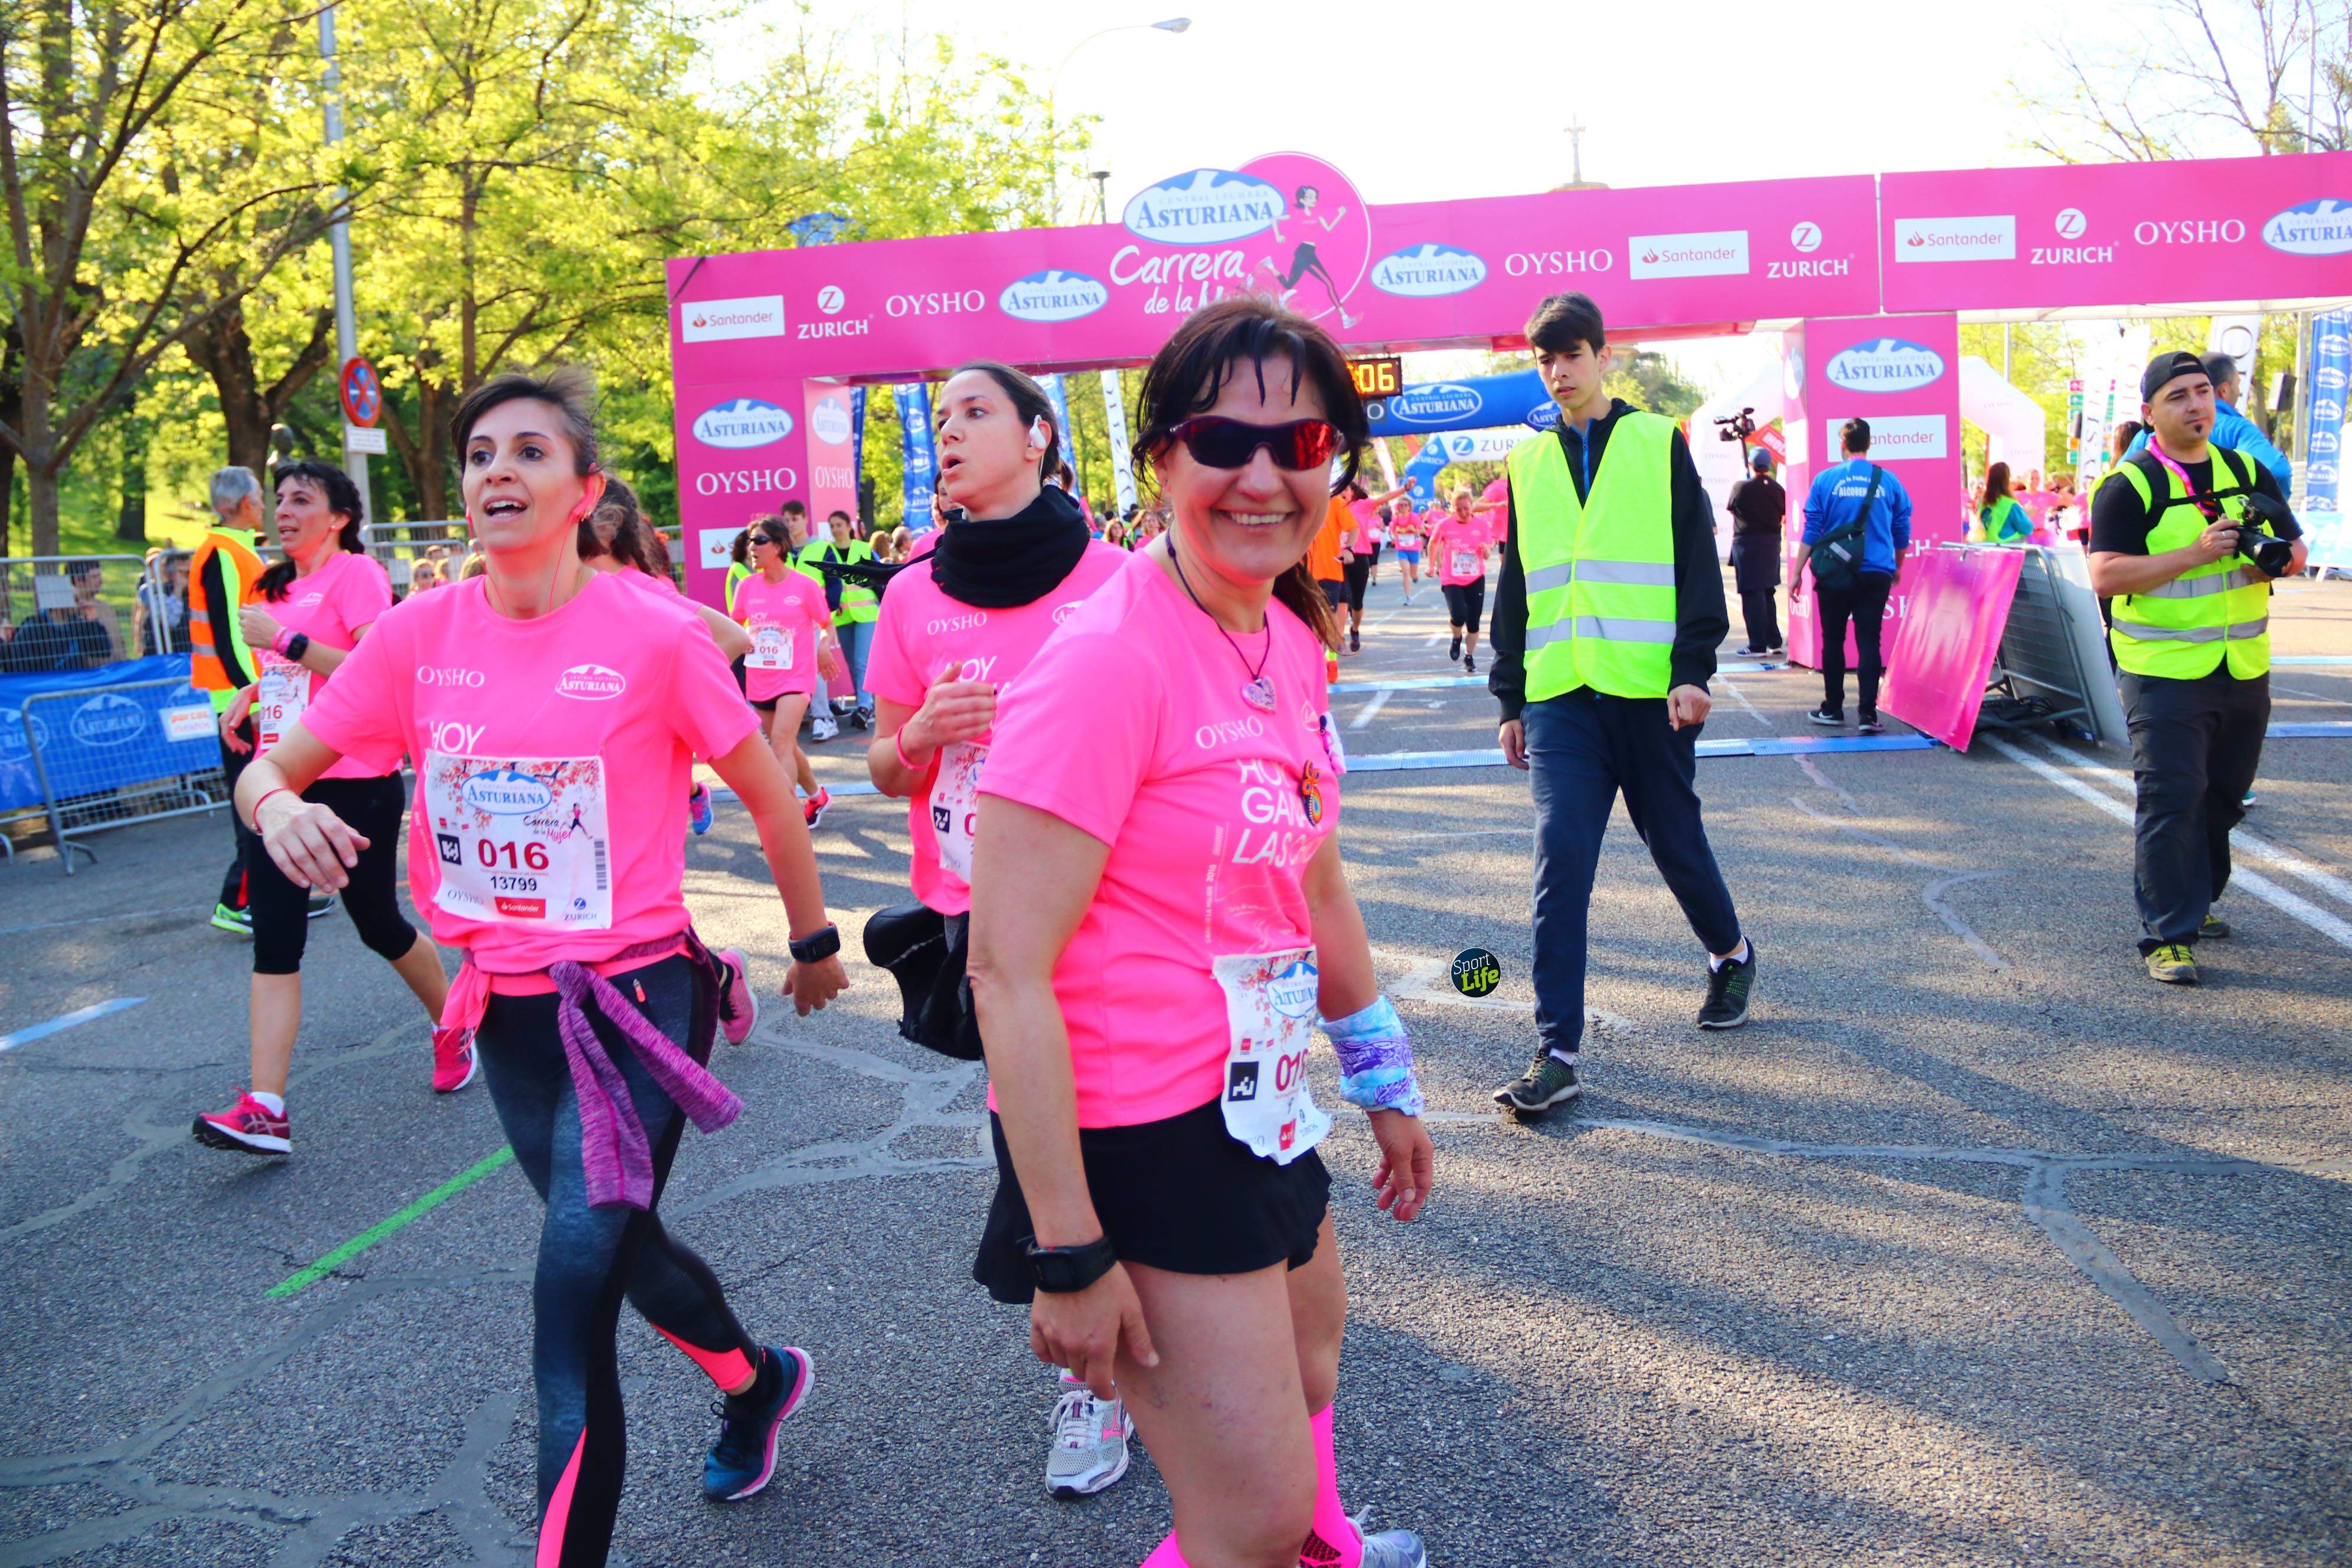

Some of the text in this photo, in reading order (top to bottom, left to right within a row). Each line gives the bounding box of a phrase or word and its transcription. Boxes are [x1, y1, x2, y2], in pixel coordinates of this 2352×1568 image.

[1159, 190, 1269, 205] CENTRAL LECHERA
[1135, 201, 1273, 229] ASTURIANA
[1928, 231, 2003, 246] Santander
[2134, 219, 2245, 244] OYSHO
[1505, 249, 1613, 276] OYSHO
[1662, 247, 1736, 263] Santander
[2030, 246, 2113, 264] ZURICH
[1109, 245, 1245, 286] Carrera
[1767, 259, 1849, 278] ZURICH
[1378, 265, 1479, 286] ASTURIANA
[886, 290, 985, 316] OYSHO
[1007, 291, 1100, 311] ASTURIANA
[1144, 286, 1169, 313] de
[1174, 282, 1193, 312] la
[709, 312, 773, 326] Santander
[798, 319, 868, 339] ZURICH
[1834, 360, 1936, 380] ASTURIANA
[1398, 398, 1475, 415] ASTURIANA
[700, 419, 786, 439] ASTURIANA
[1870, 431, 1934, 445] antander
[1481, 439, 1520, 452] ZUR
[695, 468, 796, 495] OYSHO
[815, 466, 854, 489] OYSHO
[1839, 486, 1880, 499] ALCOBENS
[927, 611, 987, 636] OYSHO
[760, 646, 779, 655] 016
[417, 665, 485, 688] OYSHO
[558, 676, 620, 692] ASTURIANA
[430, 721, 486, 754] HOY
[1195, 715, 1263, 749] OYSHO
[468, 785, 544, 804] ASTURIANA
[524, 815, 559, 827] Carrera
[545, 829, 571, 844] Mujer
[478, 838, 549, 870] 016
[490, 876, 538, 891] 13799
[508, 902, 540, 913] Santander
[564, 912, 597, 921] ZURICH
